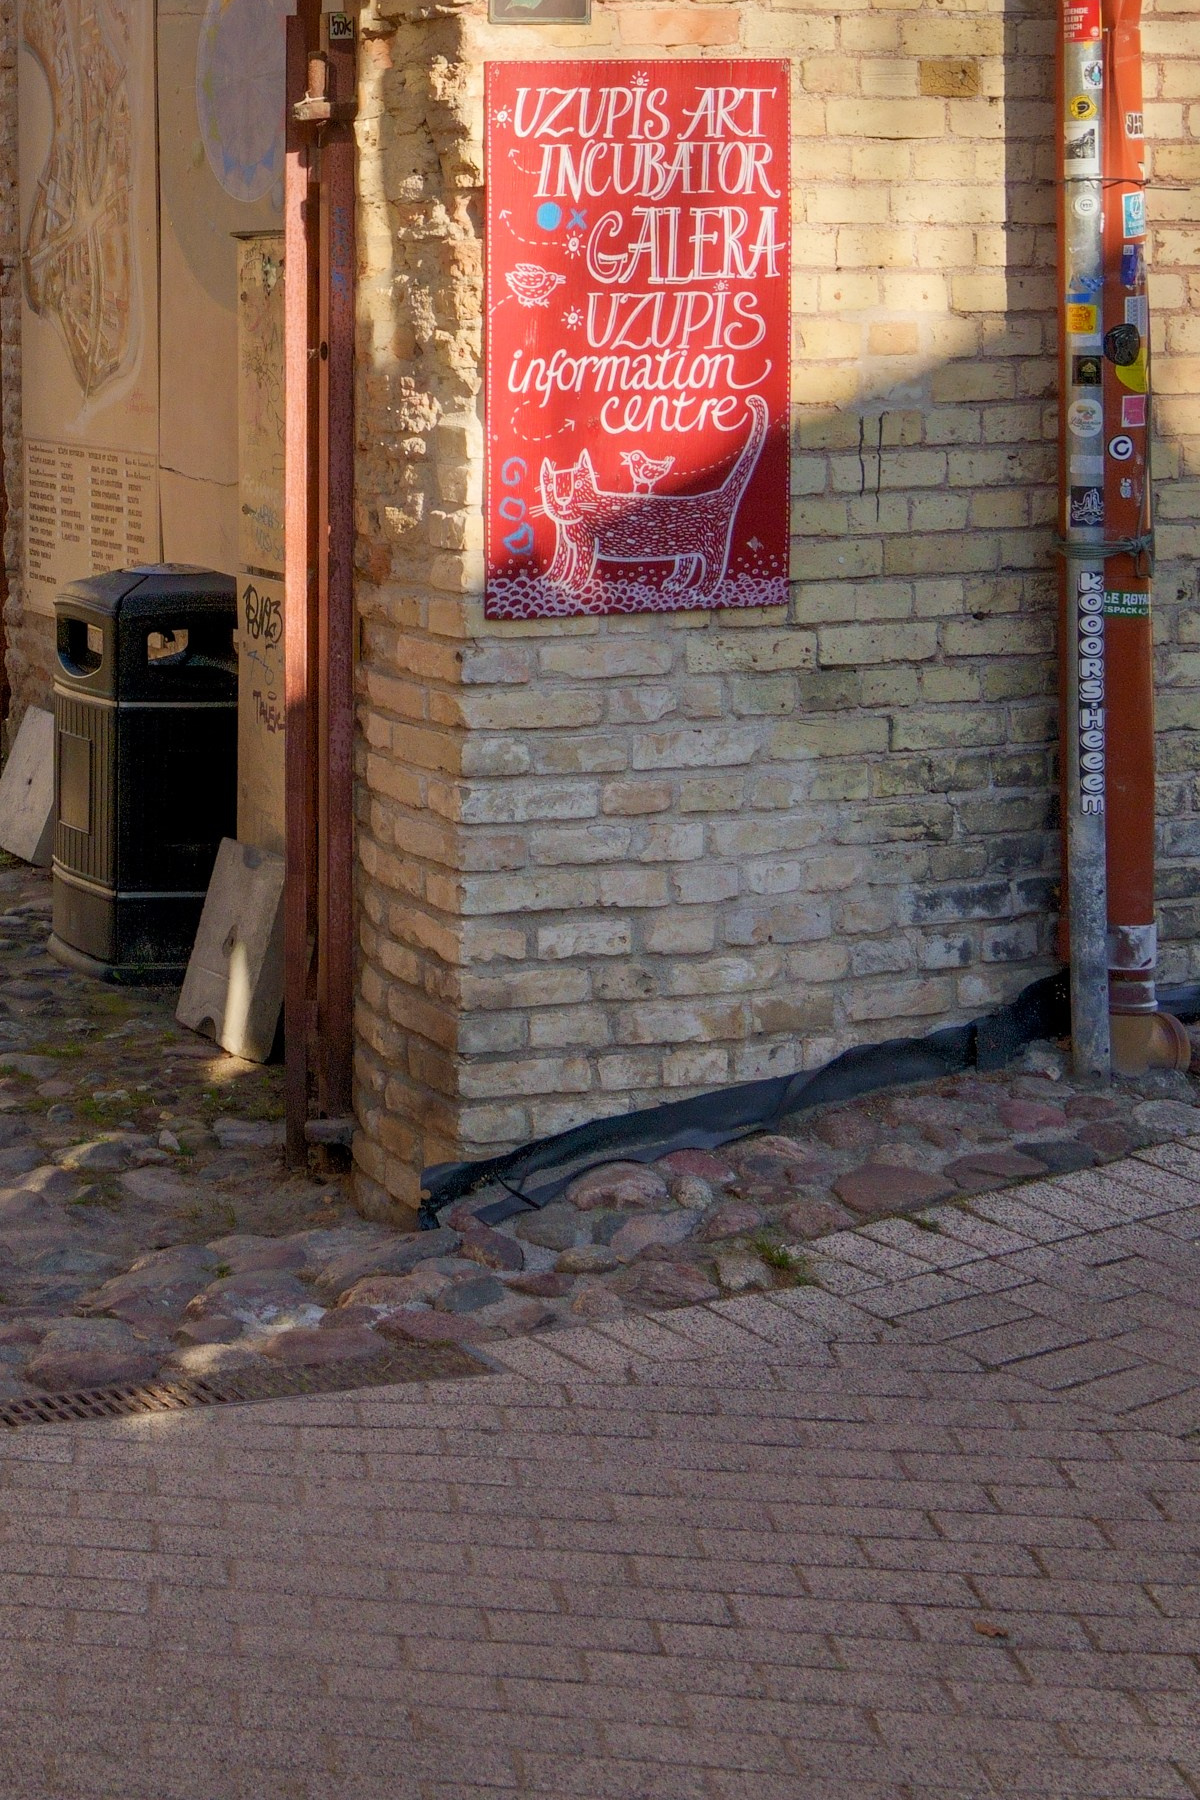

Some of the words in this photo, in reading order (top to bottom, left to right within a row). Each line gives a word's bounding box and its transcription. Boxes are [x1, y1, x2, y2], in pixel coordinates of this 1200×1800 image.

[676, 86, 777, 141] ART
[533, 139, 781, 203] INCUBATOR
[586, 205, 786, 285] GALERA
[507, 349, 772, 407] information
[600, 395, 750, 434] centre
